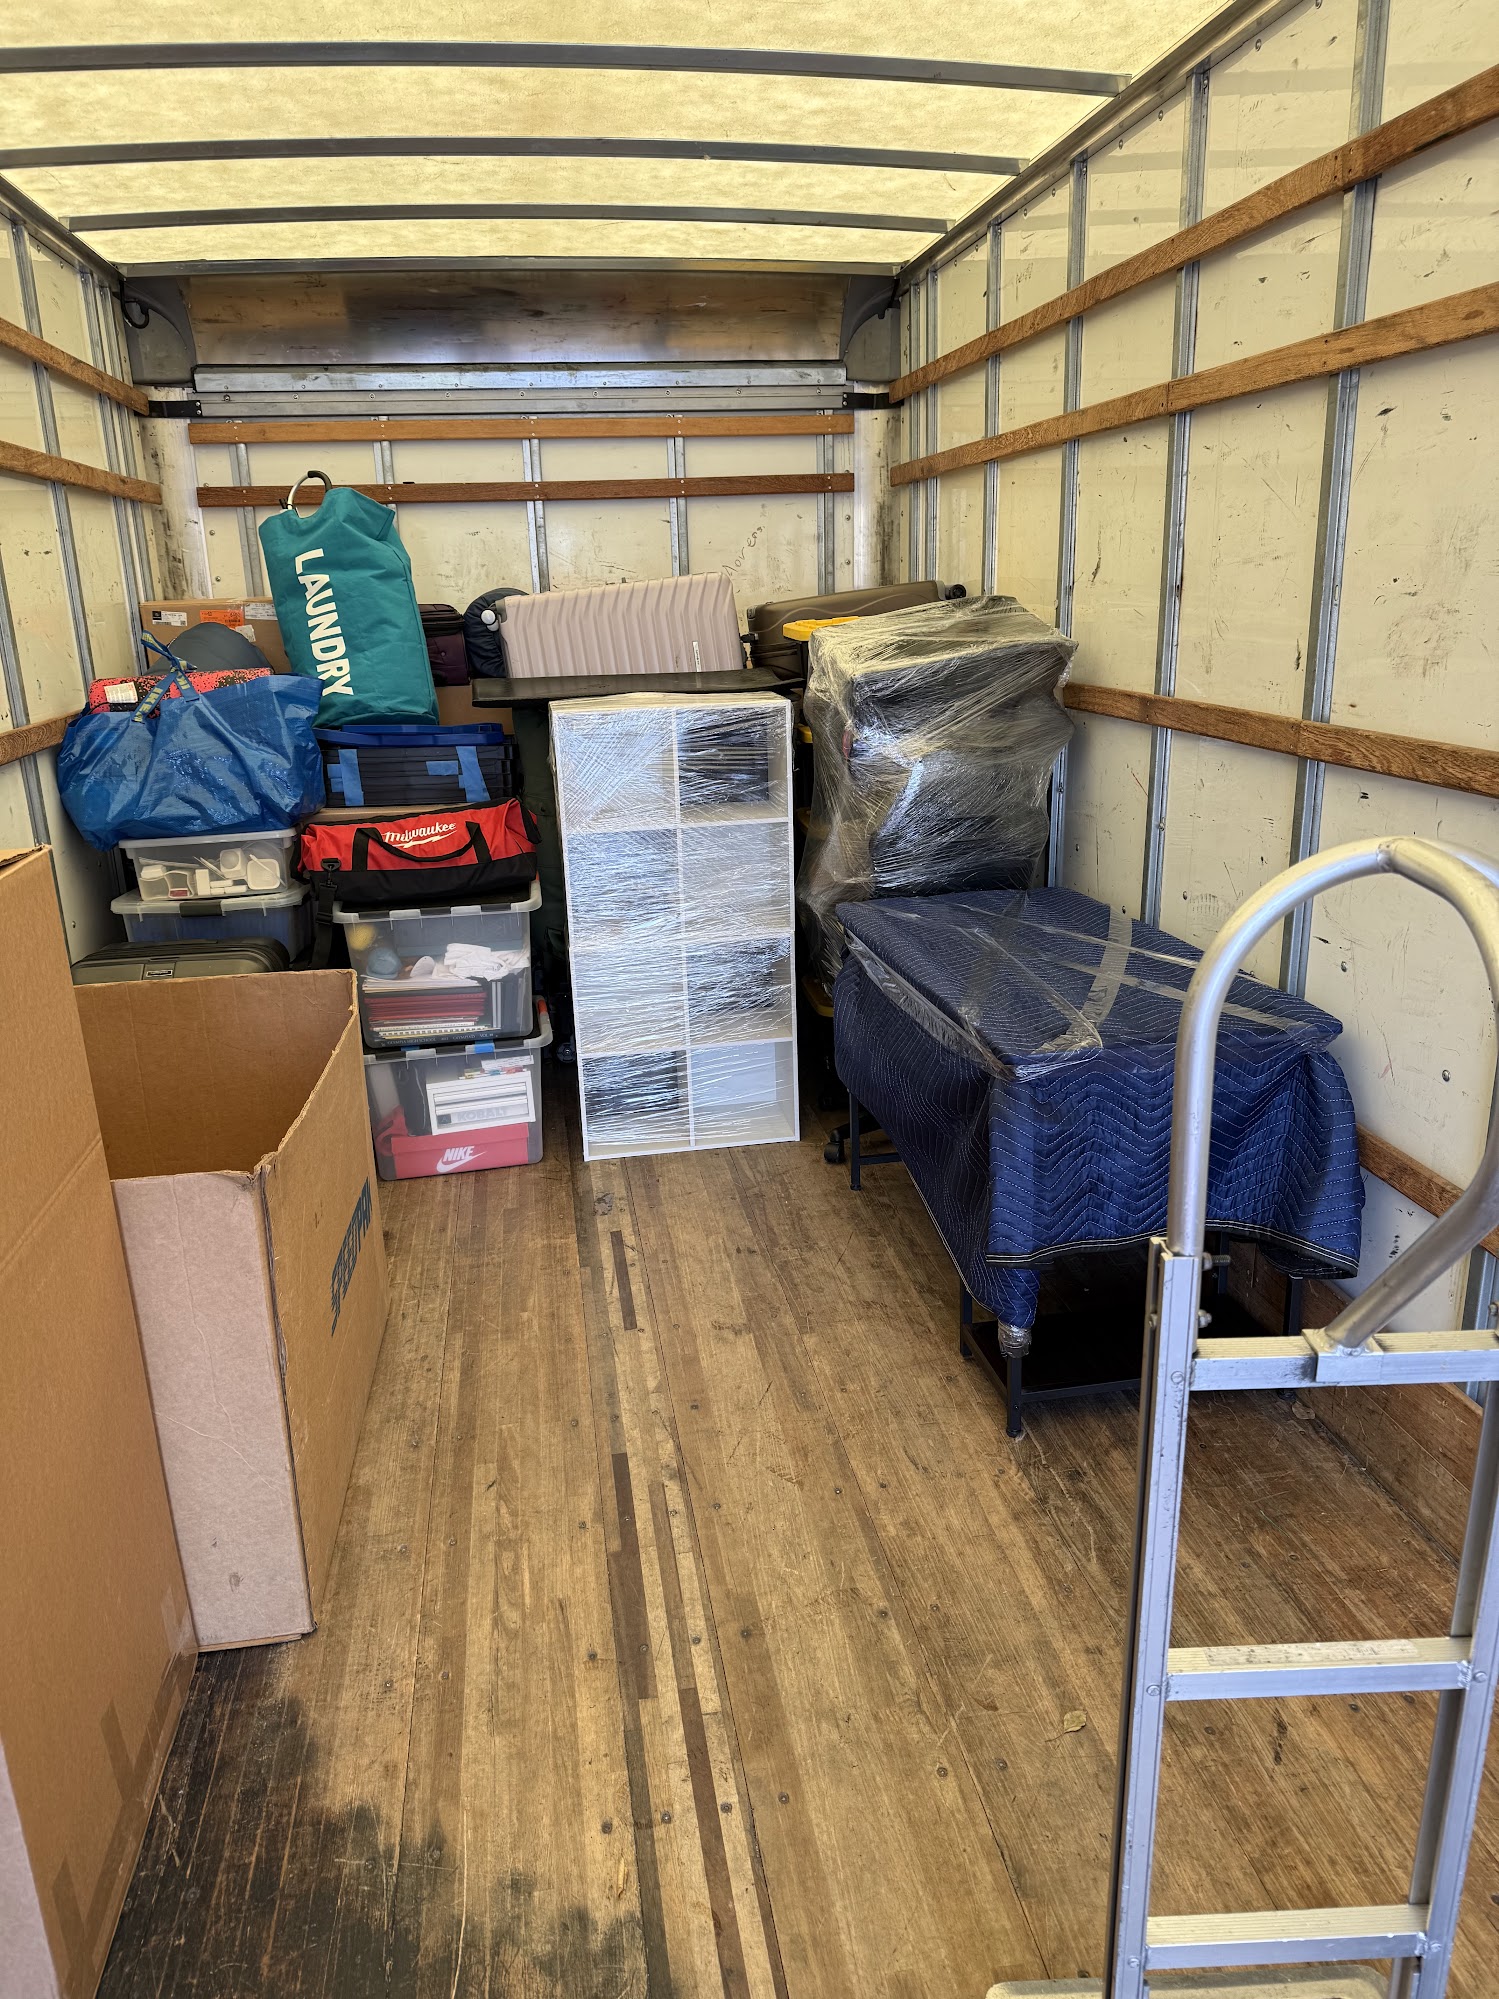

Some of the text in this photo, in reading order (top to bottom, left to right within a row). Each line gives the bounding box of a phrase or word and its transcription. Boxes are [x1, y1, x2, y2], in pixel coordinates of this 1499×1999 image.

[294, 548, 355, 697] LAUNDRY
[381, 822, 457, 843] Milwaukee
[457, 1107, 506, 1121] KOBALT
[443, 1146, 475, 1162] NIKE
